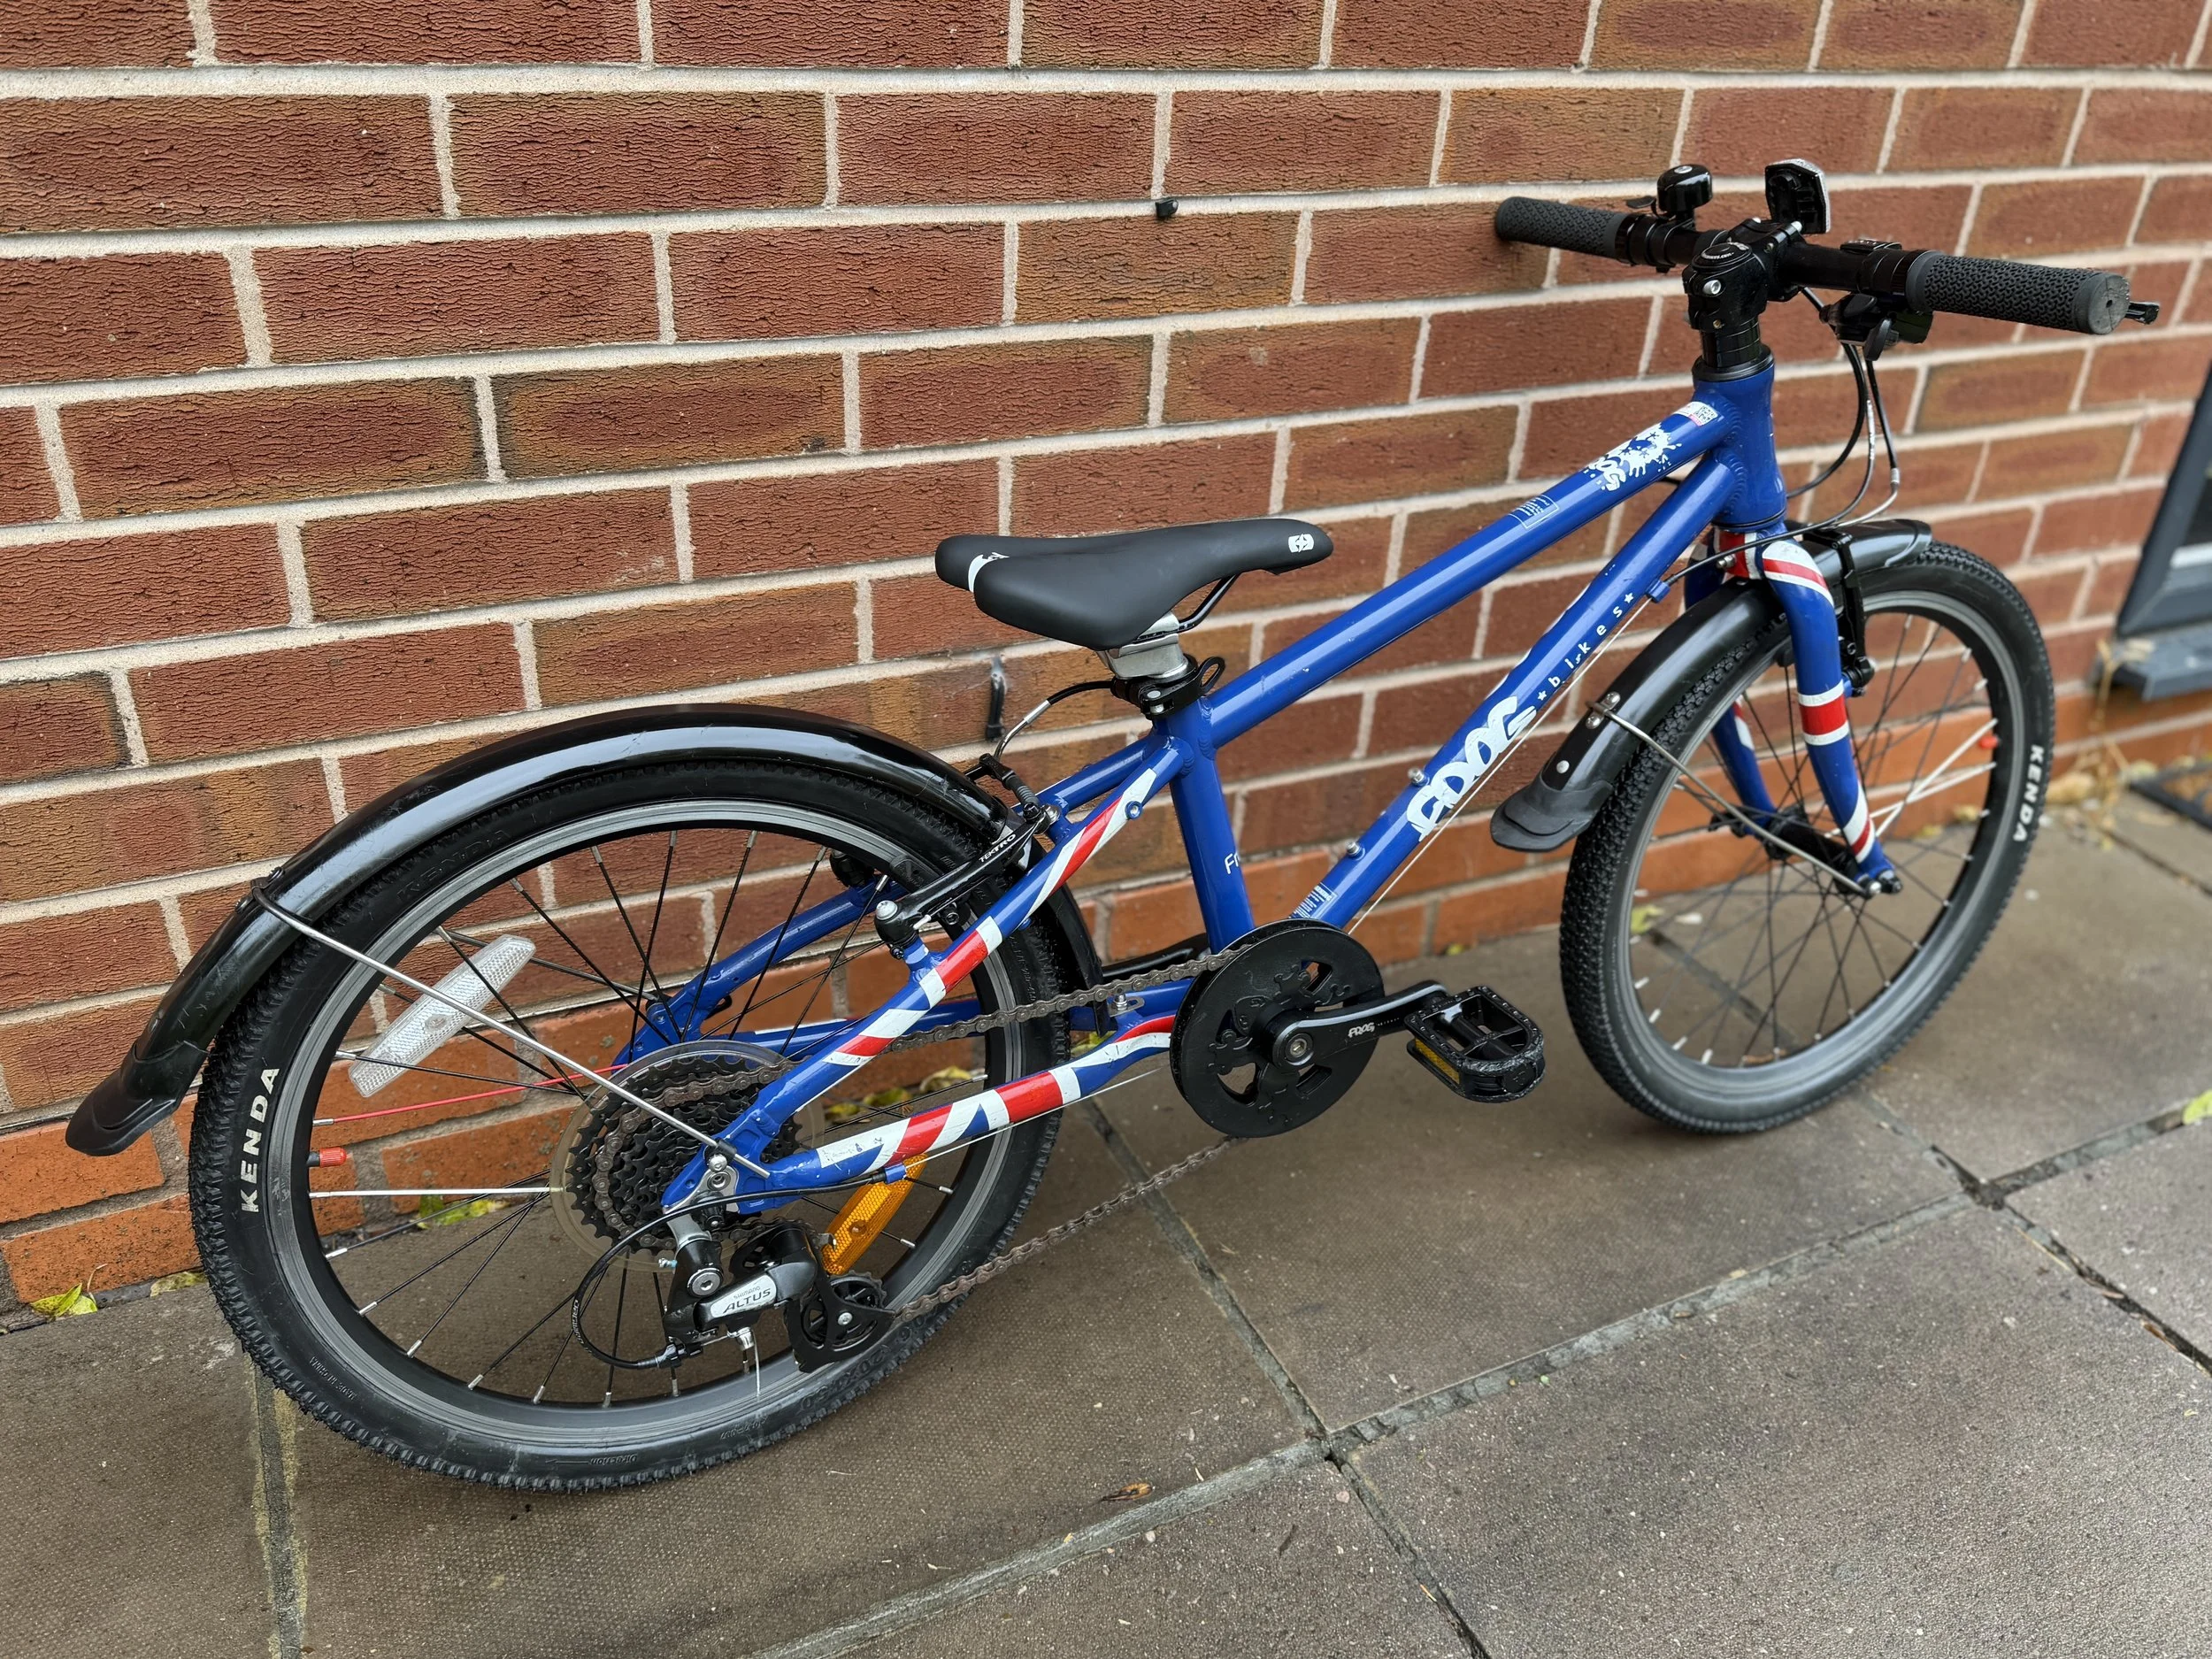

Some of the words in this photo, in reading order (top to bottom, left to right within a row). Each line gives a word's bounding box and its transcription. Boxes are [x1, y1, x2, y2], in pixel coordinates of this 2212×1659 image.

[2013, 744, 2044, 841] KENDA
[979, 833, 1018, 864] TEKTRO
[1348, 1022, 1376, 1039] FROG
[240, 1068, 280, 1213] KENDA
[723, 1288, 771, 1313] ALTUS
[733, 1285, 761, 1300] SHIMANO
